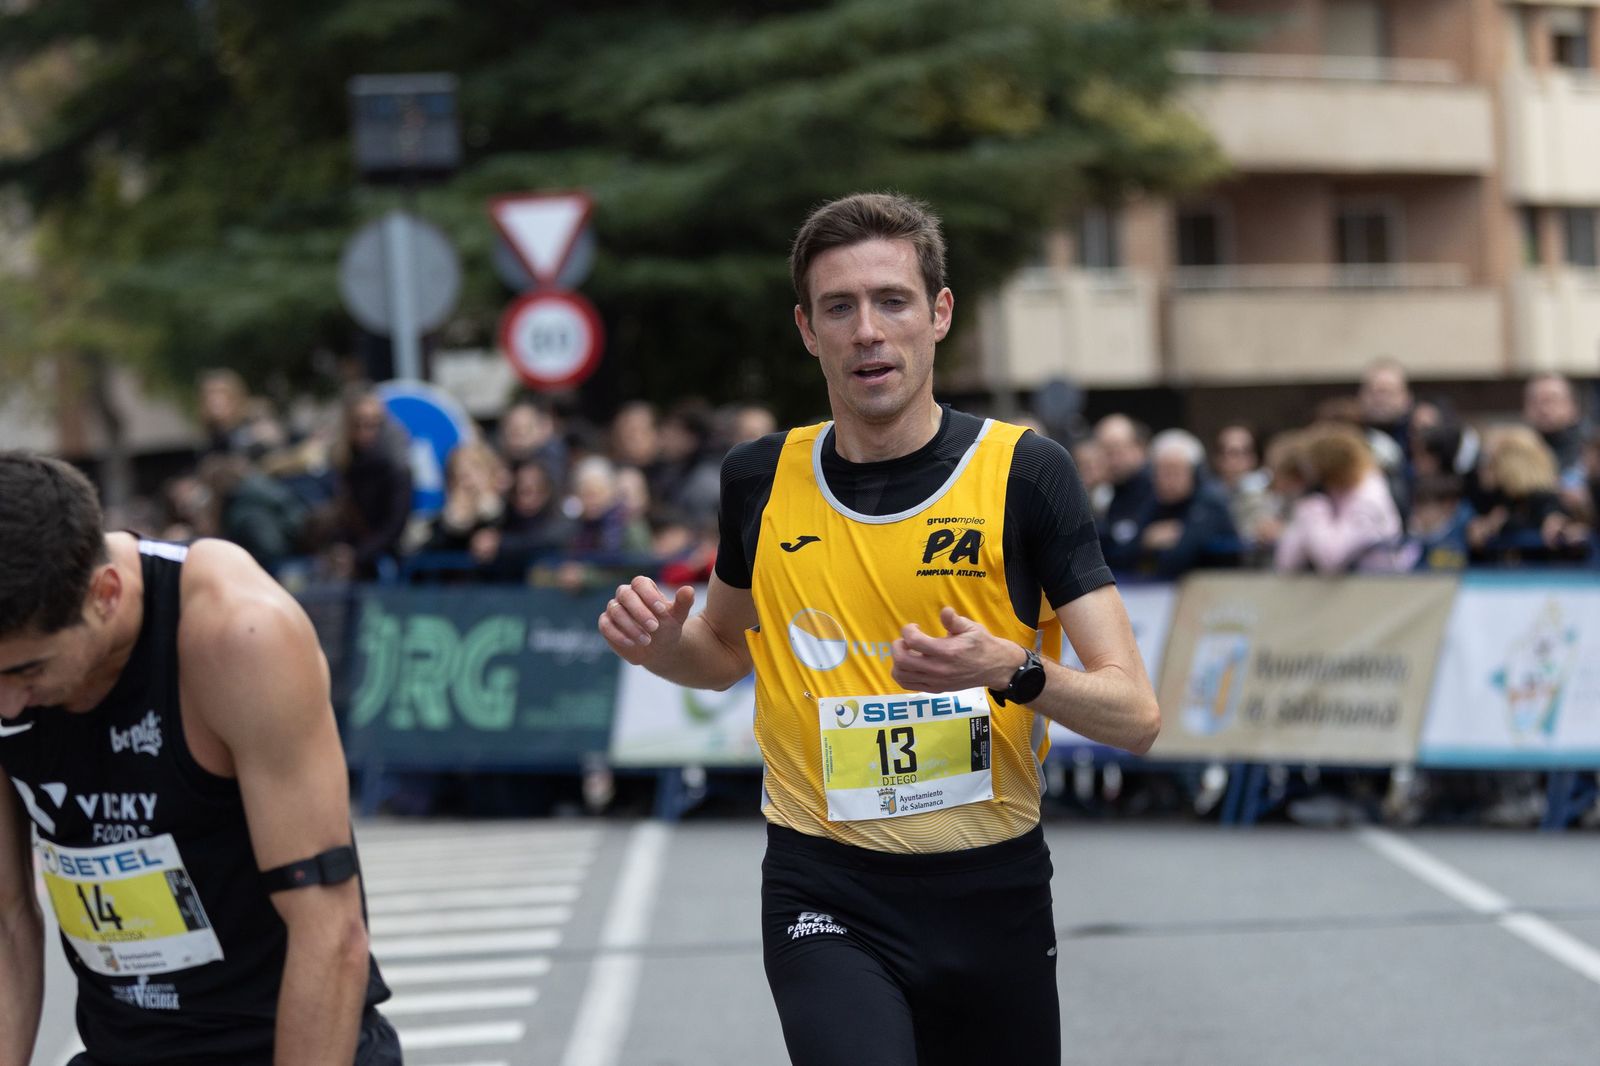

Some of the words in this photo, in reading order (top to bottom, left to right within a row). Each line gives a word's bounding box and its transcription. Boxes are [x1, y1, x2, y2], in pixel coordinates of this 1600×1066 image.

[927, 517, 985, 525] grupompleo
[922, 529, 982, 565] PA
[956, 569, 986, 577] ATLETICO
[853, 640, 894, 661] rup
[352, 607, 526, 730] JRG
[863, 696, 972, 722] SETEL
[876, 727, 917, 775] 13
[882, 774, 917, 786] DIEGO
[75, 793, 157, 820] VICKY
[899, 789, 943, 803] Ayuntamiento
[910, 799, 943, 811] Salamanca
[59, 849, 163, 876] SETEL
[77, 884, 122, 931] 14
